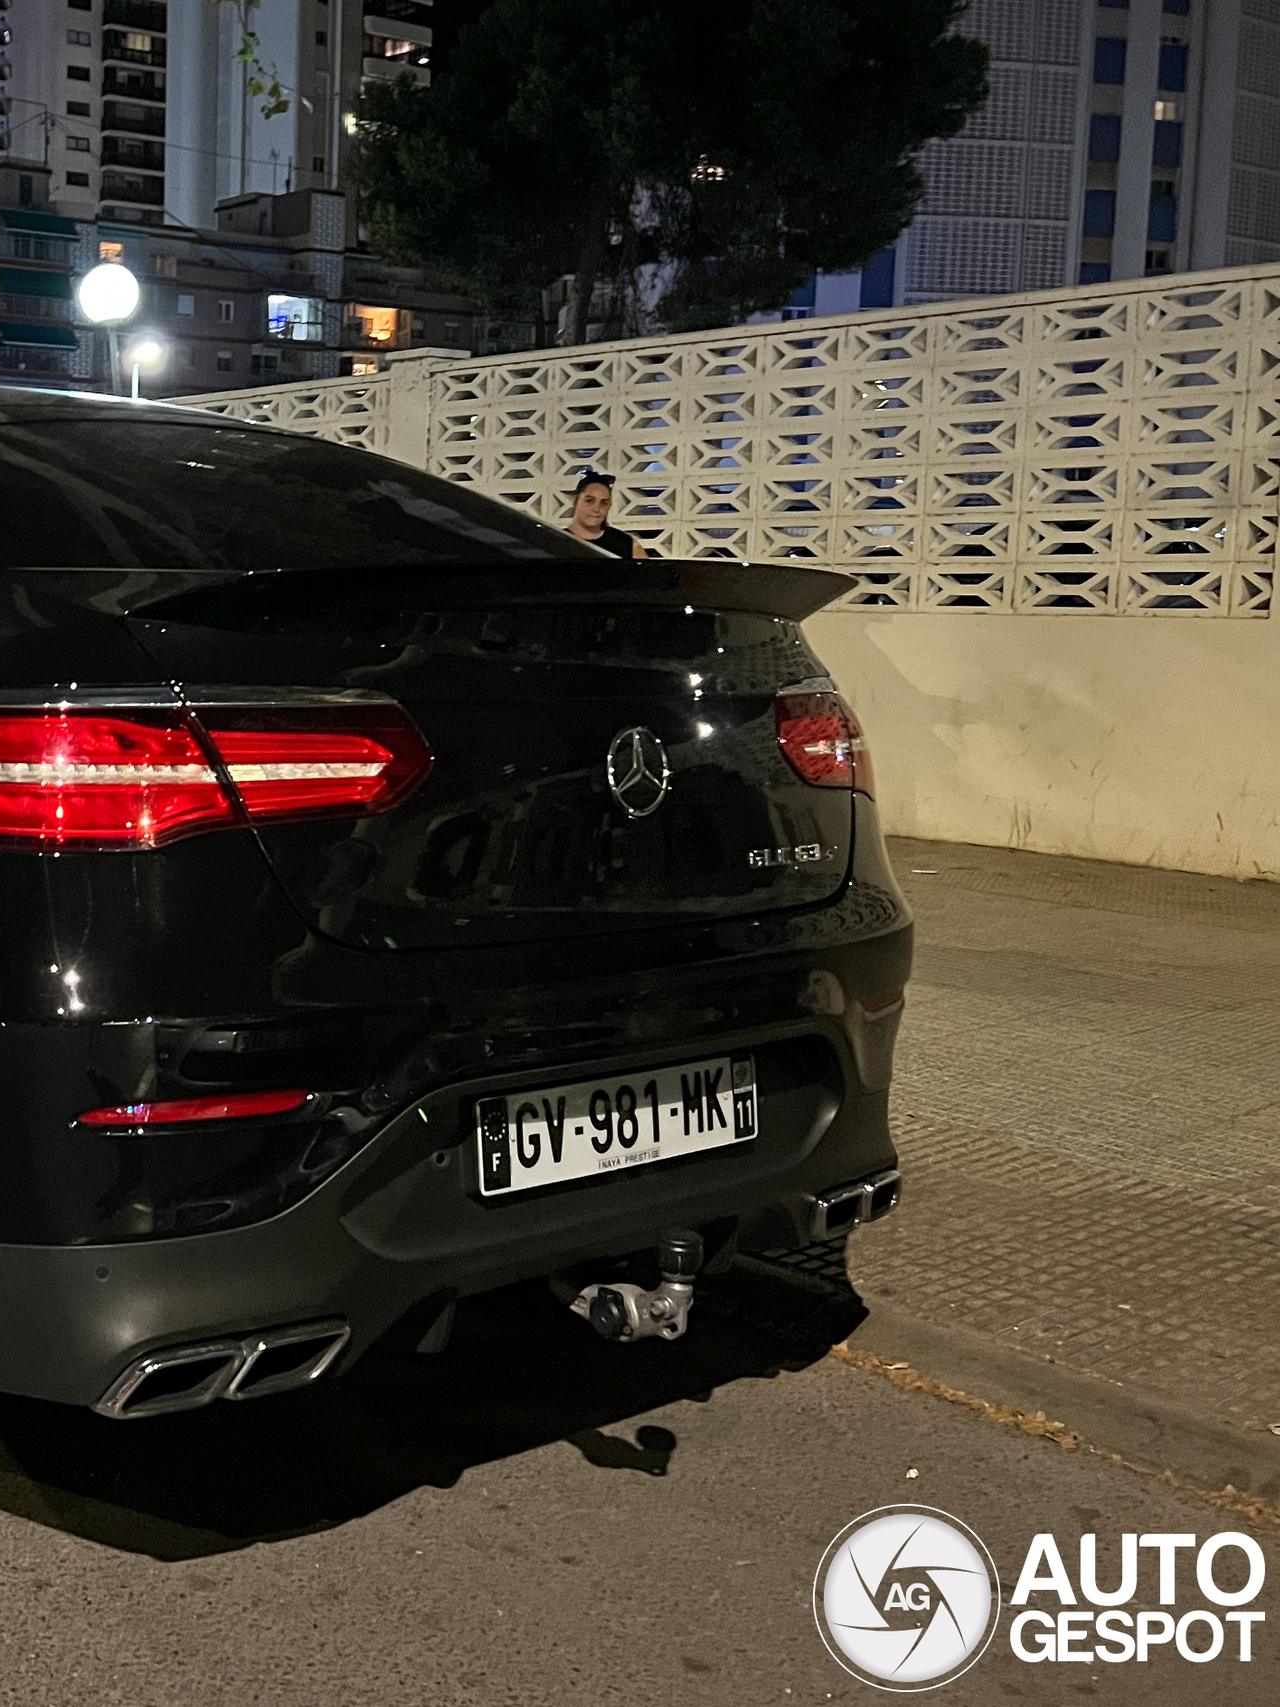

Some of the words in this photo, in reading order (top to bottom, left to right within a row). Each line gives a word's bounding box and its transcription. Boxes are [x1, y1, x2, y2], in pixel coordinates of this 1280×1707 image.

[794, 843, 821, 863] 63
[514, 1067, 728, 1169] GV-981-MK
[736, 1098, 753, 1130] 11
[491, 1151, 502, 1173] F
[598, 1158, 621, 1170] INAYA
[625, 1149, 661, 1164] PRESTIGE
